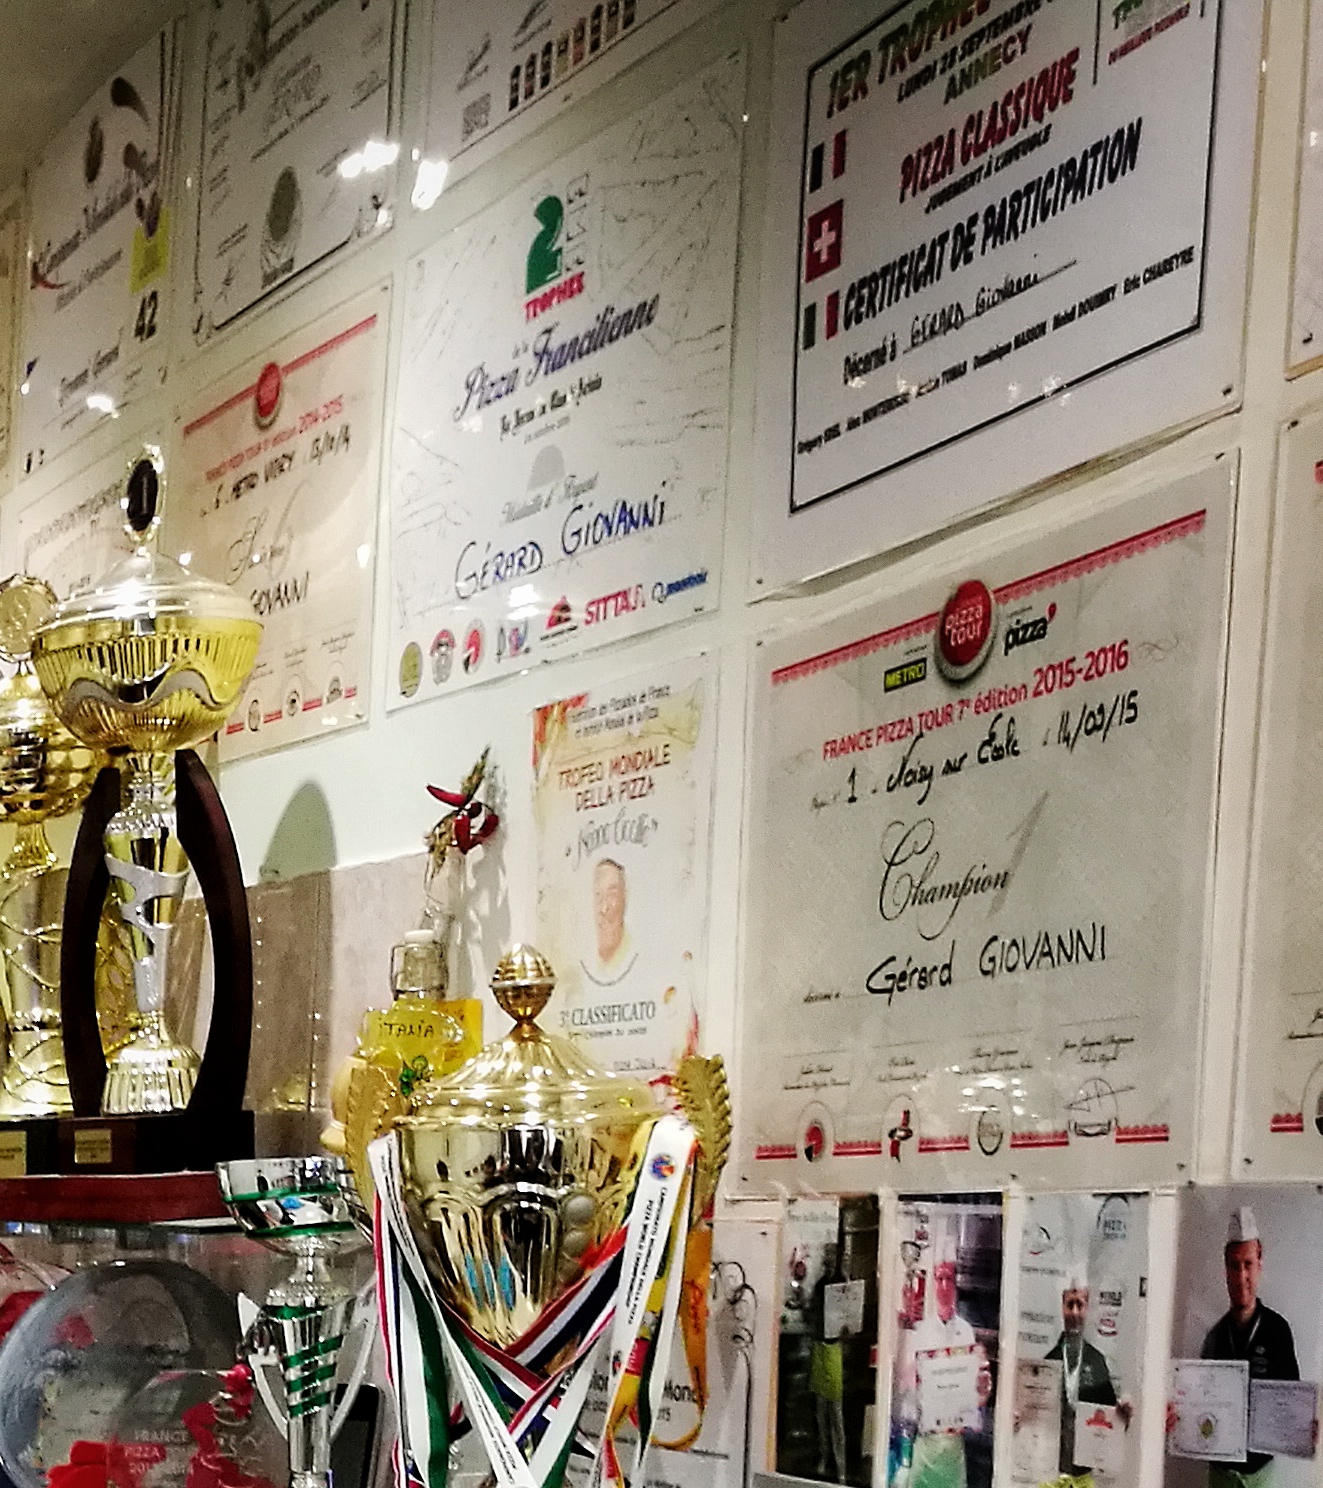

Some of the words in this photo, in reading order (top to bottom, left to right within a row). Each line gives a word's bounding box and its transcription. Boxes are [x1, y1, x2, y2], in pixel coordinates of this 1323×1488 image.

[827, 49, 871, 118] 1ER
[943, 22, 1032, 105] ANNECY
[899, 127, 955, 204] PIZZA
[959, 46, 1080, 166] CLASSIQUE
[842, 224, 951, 332] CERTIFICAT
[950, 208, 979, 273] DE
[980, 117, 1143, 256] PARTICIPATION
[885, 660, 926, 688] METRO
[1004, 615, 1047, 656] pizza
[822, 729, 873, 761] FRANCE
[875, 718, 915, 745] PIZZA
[918, 704, 953, 732] TOUR
[973, 683, 1028, 717] édition
[1032, 639, 1130, 699] 2015-2016
[575, 785, 613, 812] DELLA
[877, 816, 1011, 941] Champion
[865, 939, 952, 1005] Gérard
[977, 922, 1107, 980] GIOVANNI
[571, 1000, 656, 1026] CLASSIFICATO
